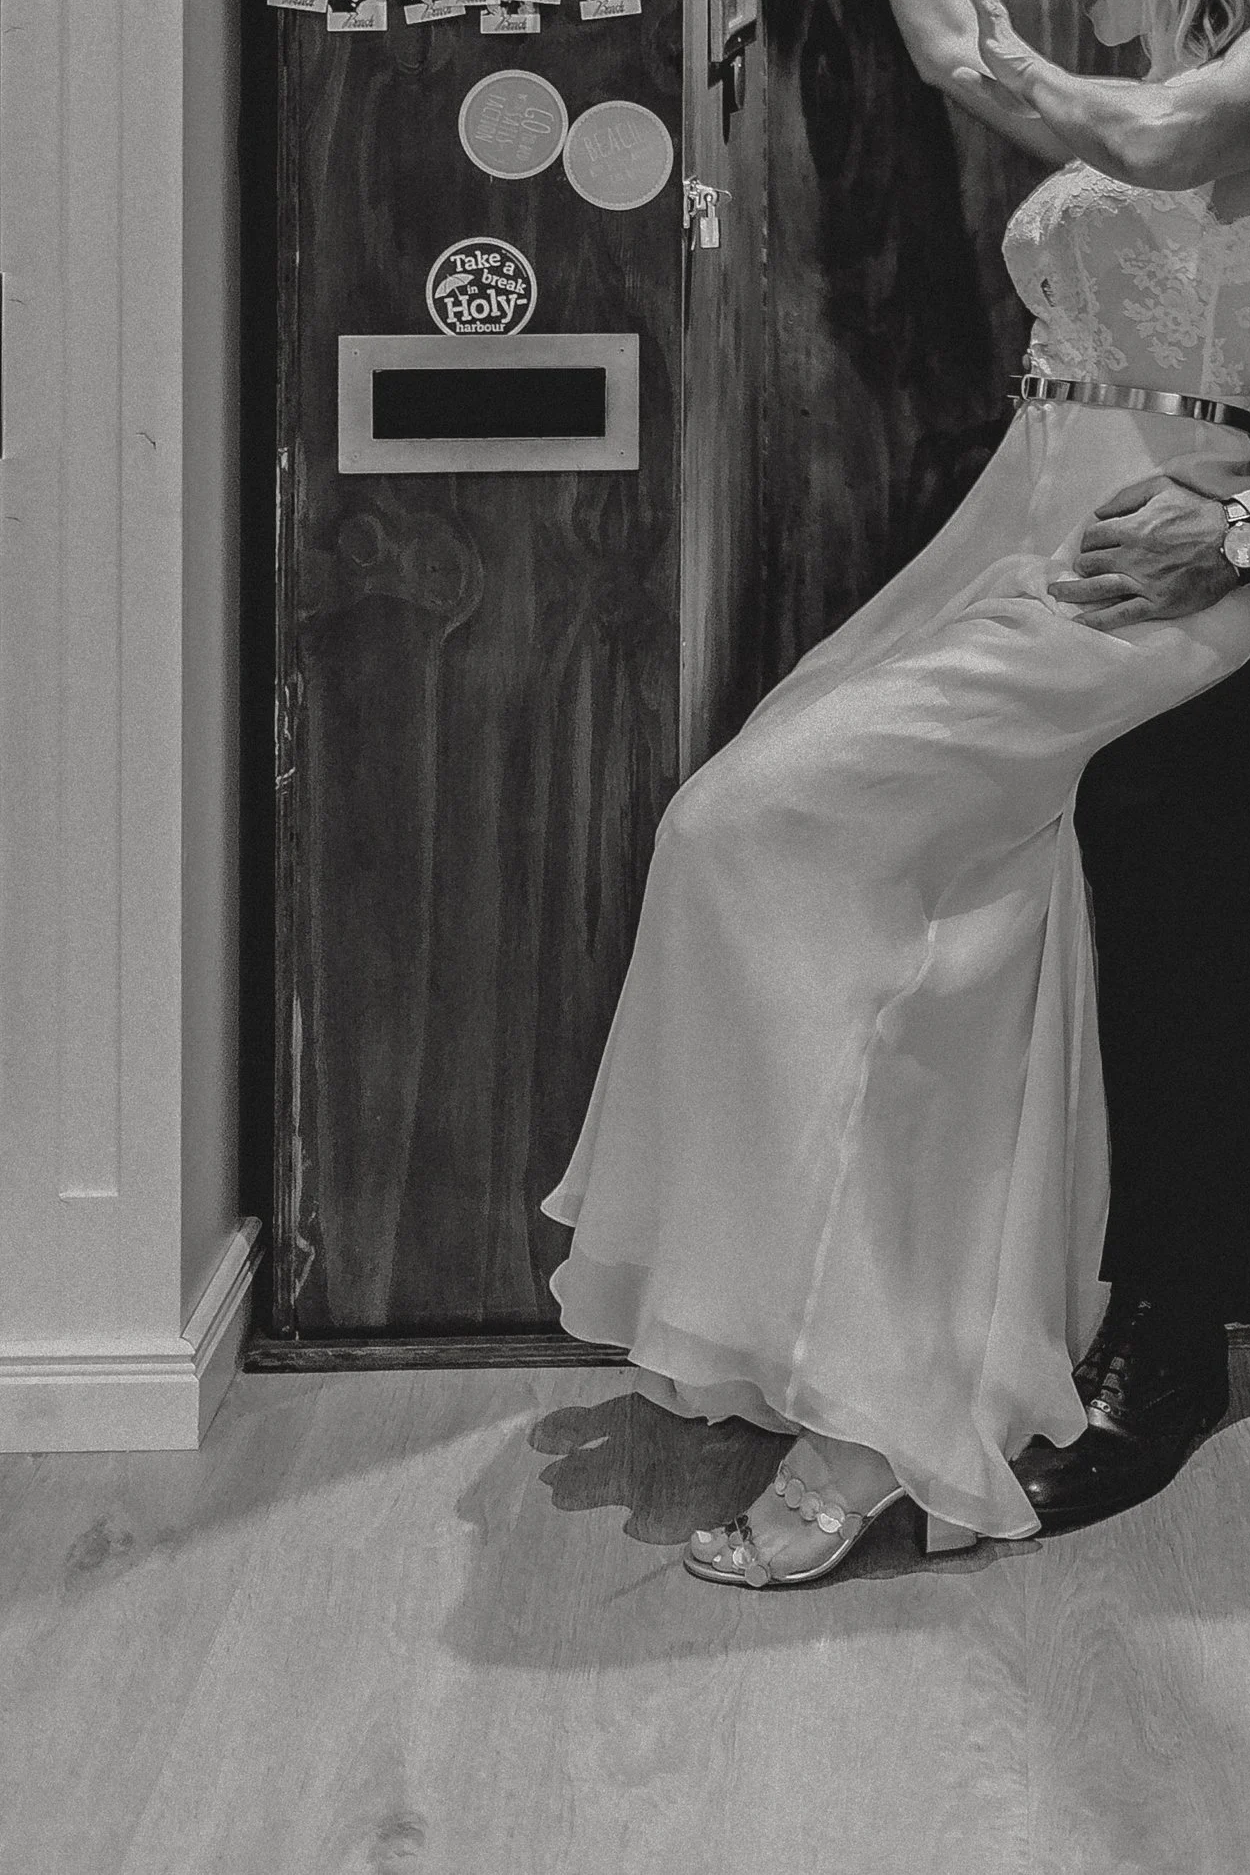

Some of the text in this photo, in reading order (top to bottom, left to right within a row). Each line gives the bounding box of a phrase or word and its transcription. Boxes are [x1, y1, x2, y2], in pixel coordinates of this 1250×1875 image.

[521, 108, 554, 134] GO
[450, 251, 501, 272] Take
[503, 261, 515, 275] a
[467, 285, 479, 294] in
[482, 268, 526, 294] break
[444, 289, 528, 323] Holy-
[455, 321, 506, 332] harbour
